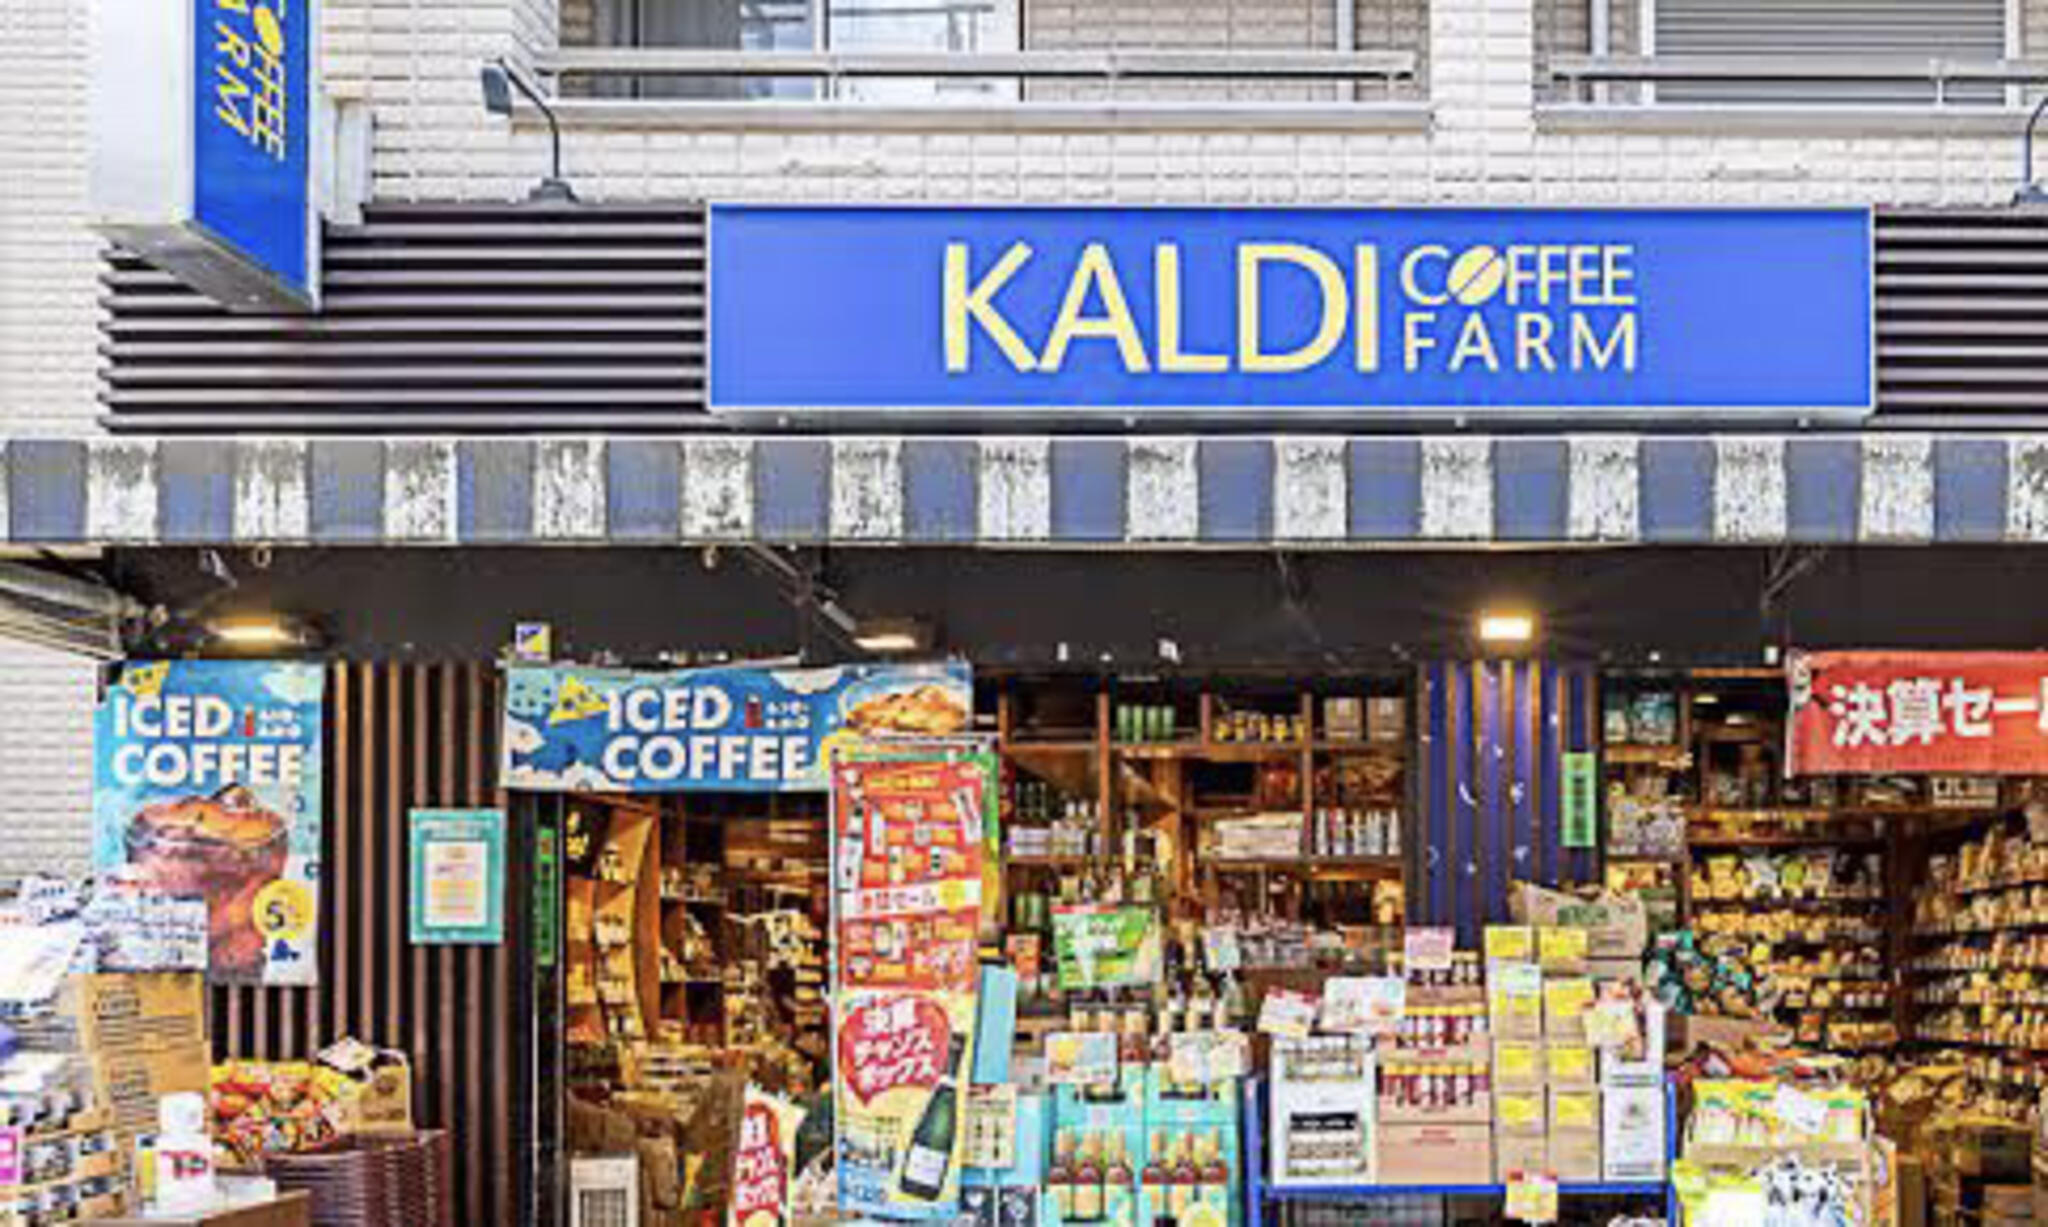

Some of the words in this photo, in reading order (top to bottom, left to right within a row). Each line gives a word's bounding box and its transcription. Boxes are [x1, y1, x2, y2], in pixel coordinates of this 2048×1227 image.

[253, 0, 286, 161] OFFEE
[944, 242, 1379, 372] KALDI
[1400, 244, 1637, 306] COFFEE
[1402, 312, 1637, 372] FARM
[114, 694, 234, 738] ICED
[607, 686, 732, 732] ICED
[112, 743, 304, 786] COFFEE
[602, 735, 812, 780] COFFEE
